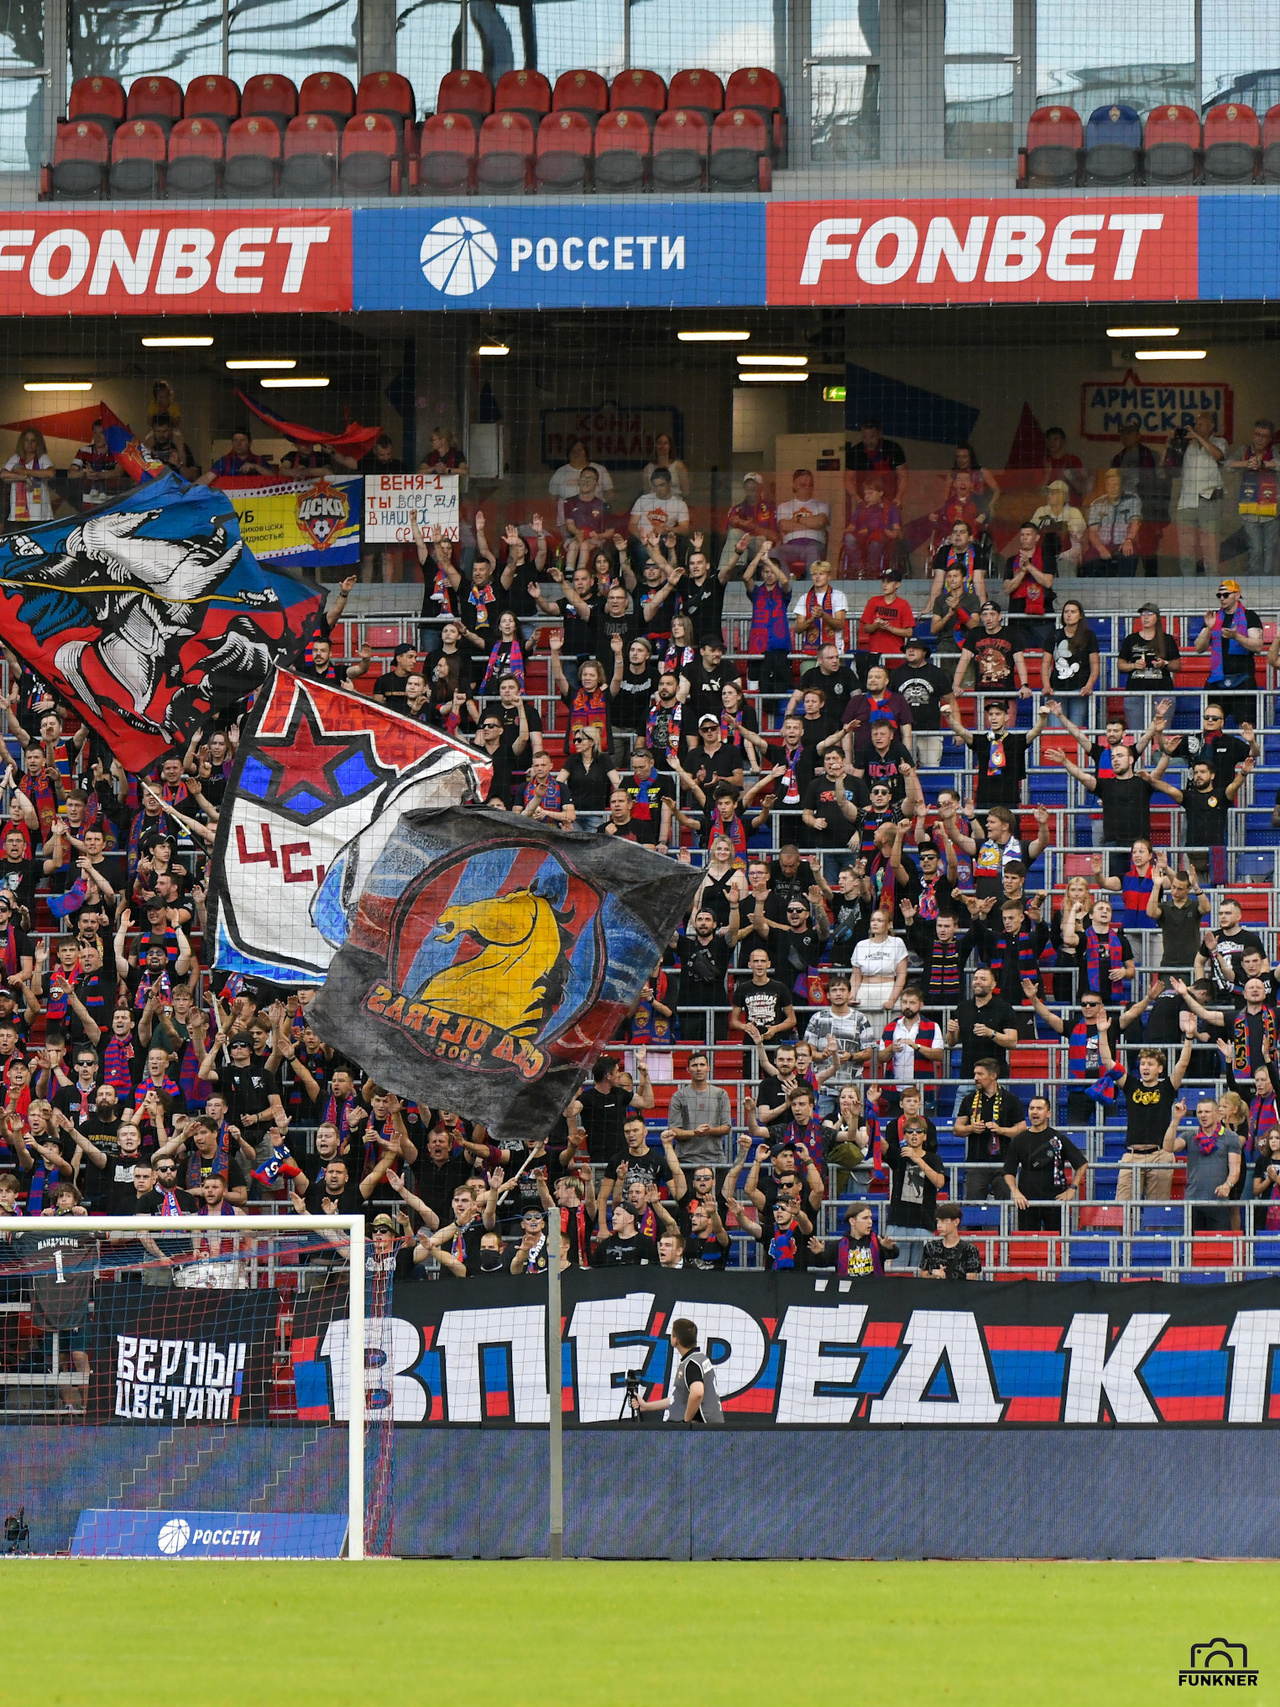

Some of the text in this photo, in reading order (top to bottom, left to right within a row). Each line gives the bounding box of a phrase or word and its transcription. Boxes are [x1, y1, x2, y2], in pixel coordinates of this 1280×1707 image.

[511, 235, 685, 272] РОССЕТИ
[800, 213, 1164, 286] FONBET
[1091, 387, 1221, 411] АРМЕЙЦЫ
[1104, 411, 1218, 433] МОСКВ
[380, 475, 443, 490] ВЕНЯ-1
[298, 497, 346, 520] ЦСКА
[367, 496, 391, 509] ТЫ
[367, 509, 430, 526] В НАШХ
[395, 526, 458, 542] СЕДАХ
[235, 822, 324, 884] ЦС
[745, 994, 777, 1005] ORIGINAL
[1234, 1018, 1247, 1071] CSKA
[53, 1250, 66, 1284] 1
[116, 1334, 237, 1387] ВЕРНЫ
[320, 1279, 1005, 1424] ВПЕРЁД
[1063, 1313, 1172, 1424] К
[114, 1380, 233, 1420] ЦВЕТАМ
[193, 1529, 261, 1546] РОССЕТИ
